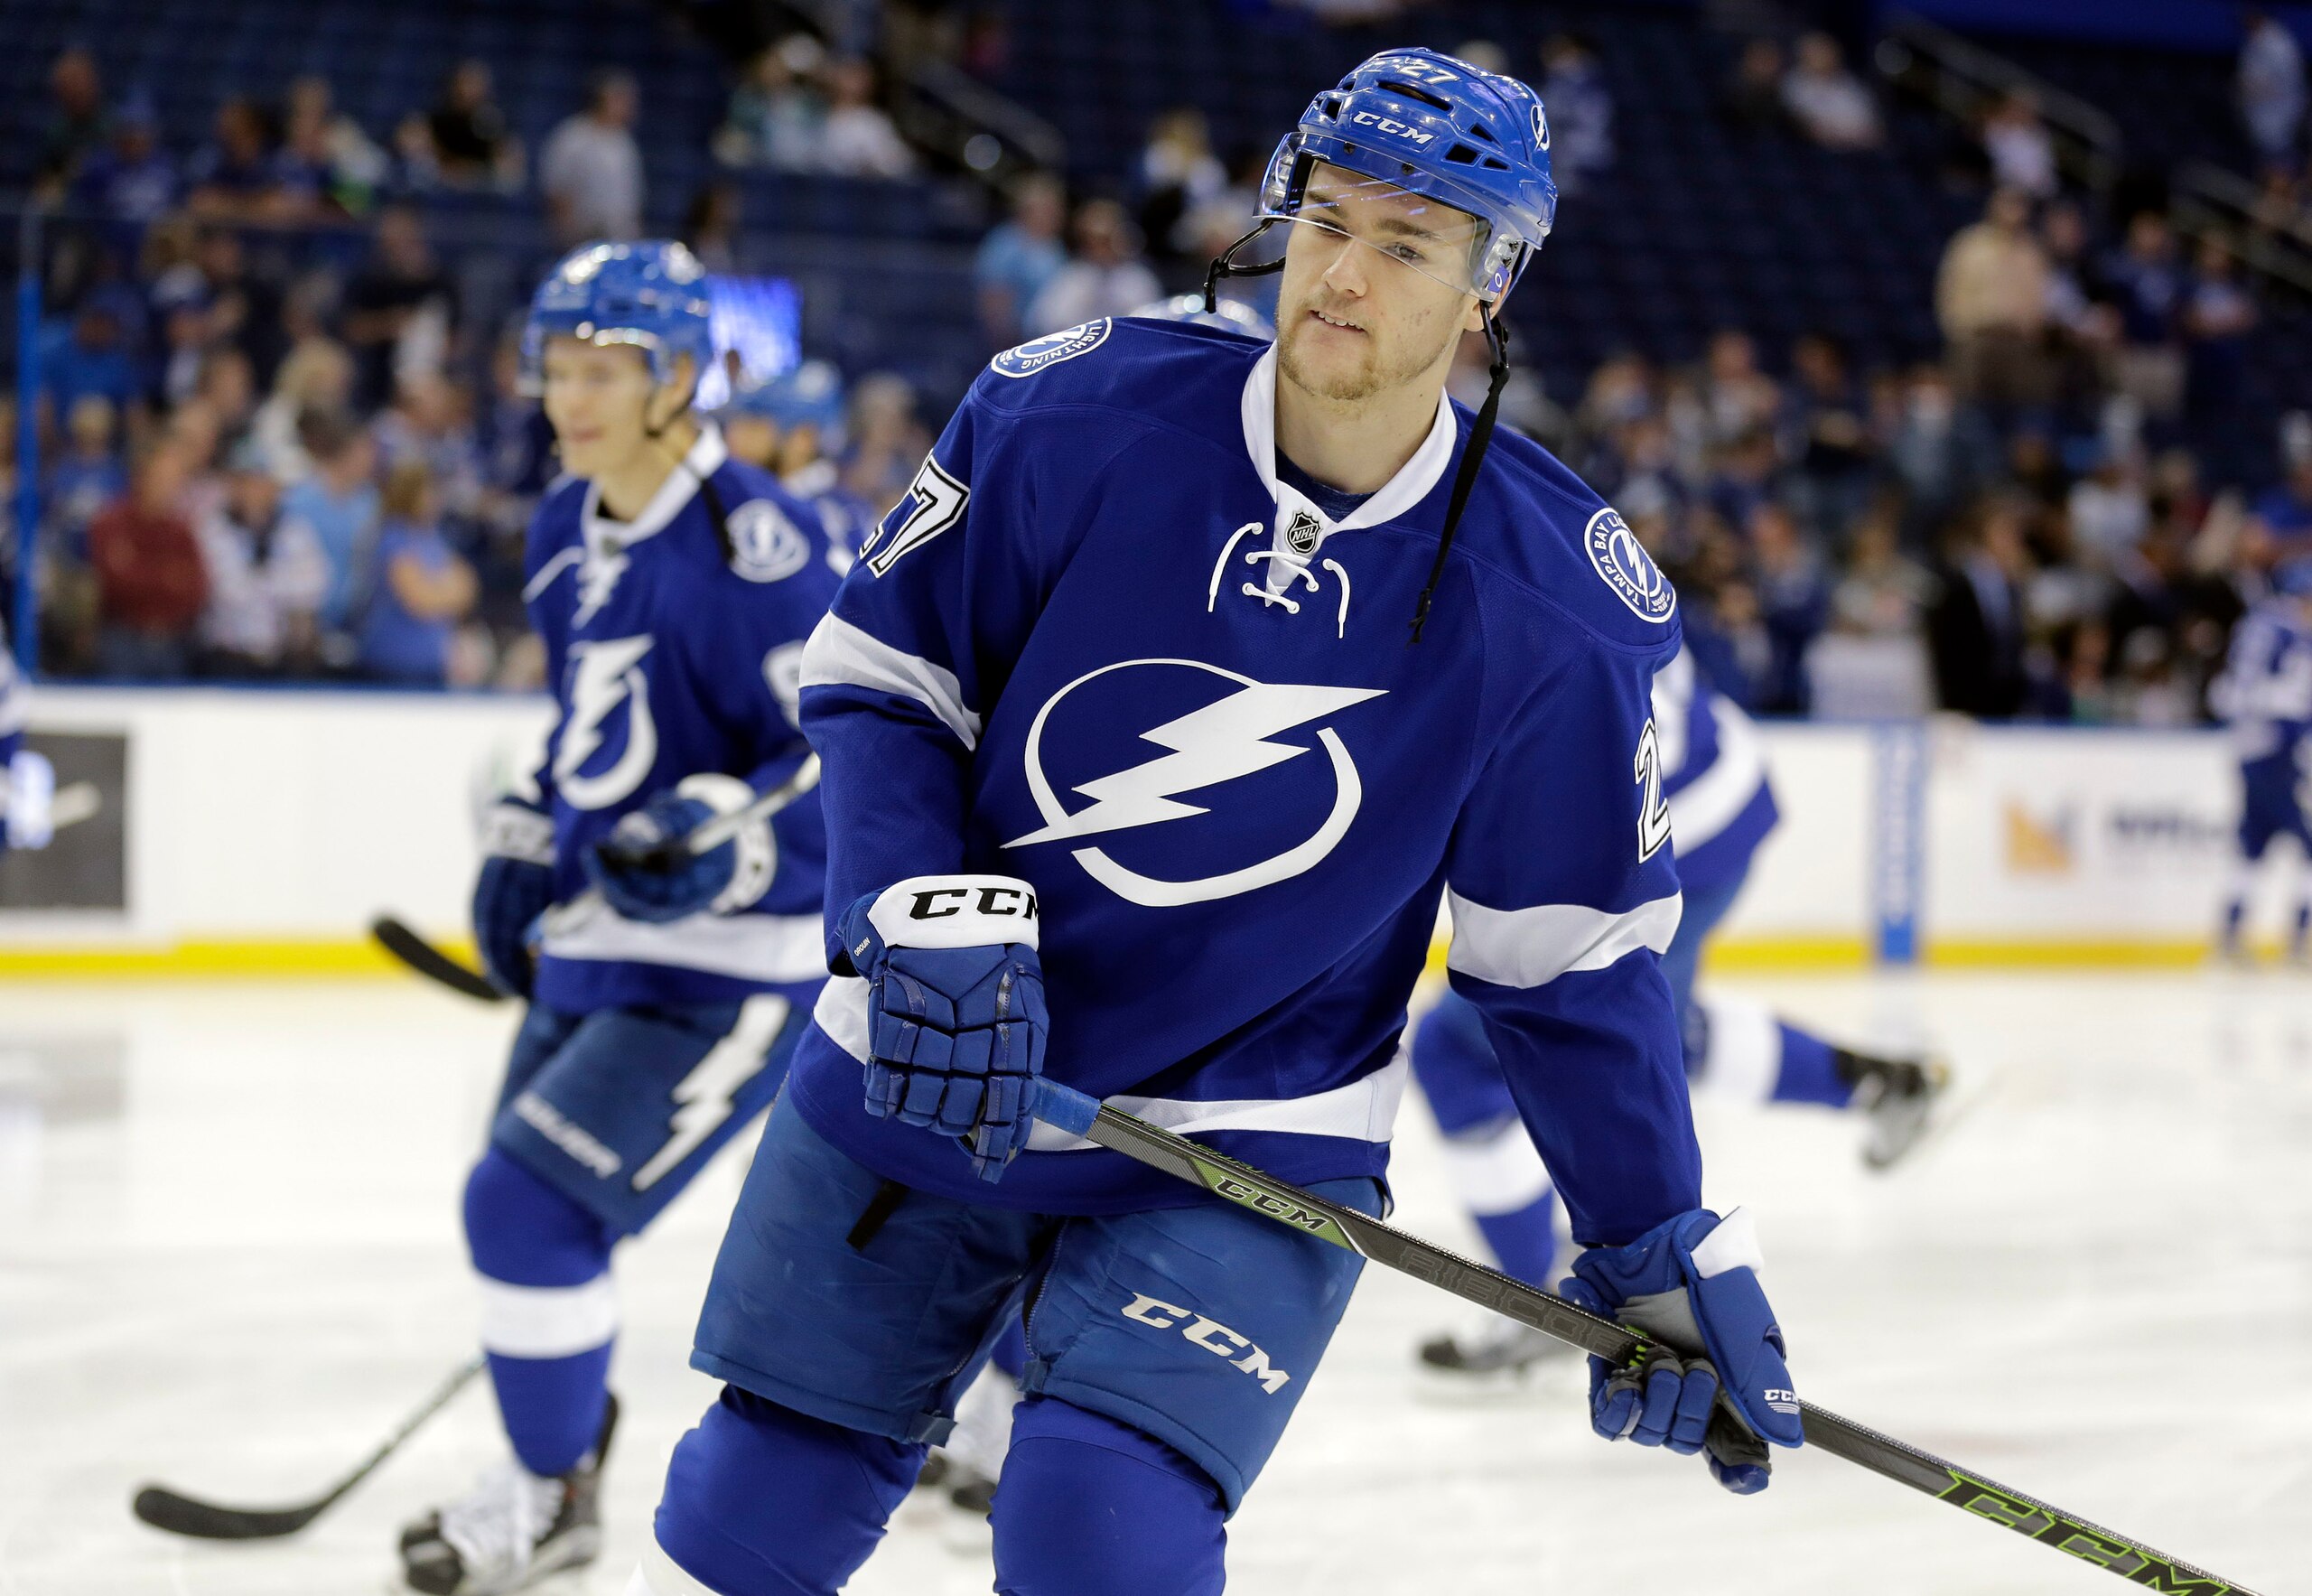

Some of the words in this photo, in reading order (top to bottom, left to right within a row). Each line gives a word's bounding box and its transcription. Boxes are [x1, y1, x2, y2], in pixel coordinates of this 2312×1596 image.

[1396, 61, 1461, 85] 27
[1353, 110, 1434, 145] CCM
[1021, 325, 1103, 369] LIGHTNING
[859, 448, 971, 578] 7
[1291, 527, 1315, 542] NHL
[1594, 522, 1610, 551] BAY
[1599, 556, 1640, 606] TAMPA
[1215, 1175, 1329, 1232] CCM
[1121, 1292, 1291, 1395] CCM
[1936, 1469, 2231, 1596] CCM
